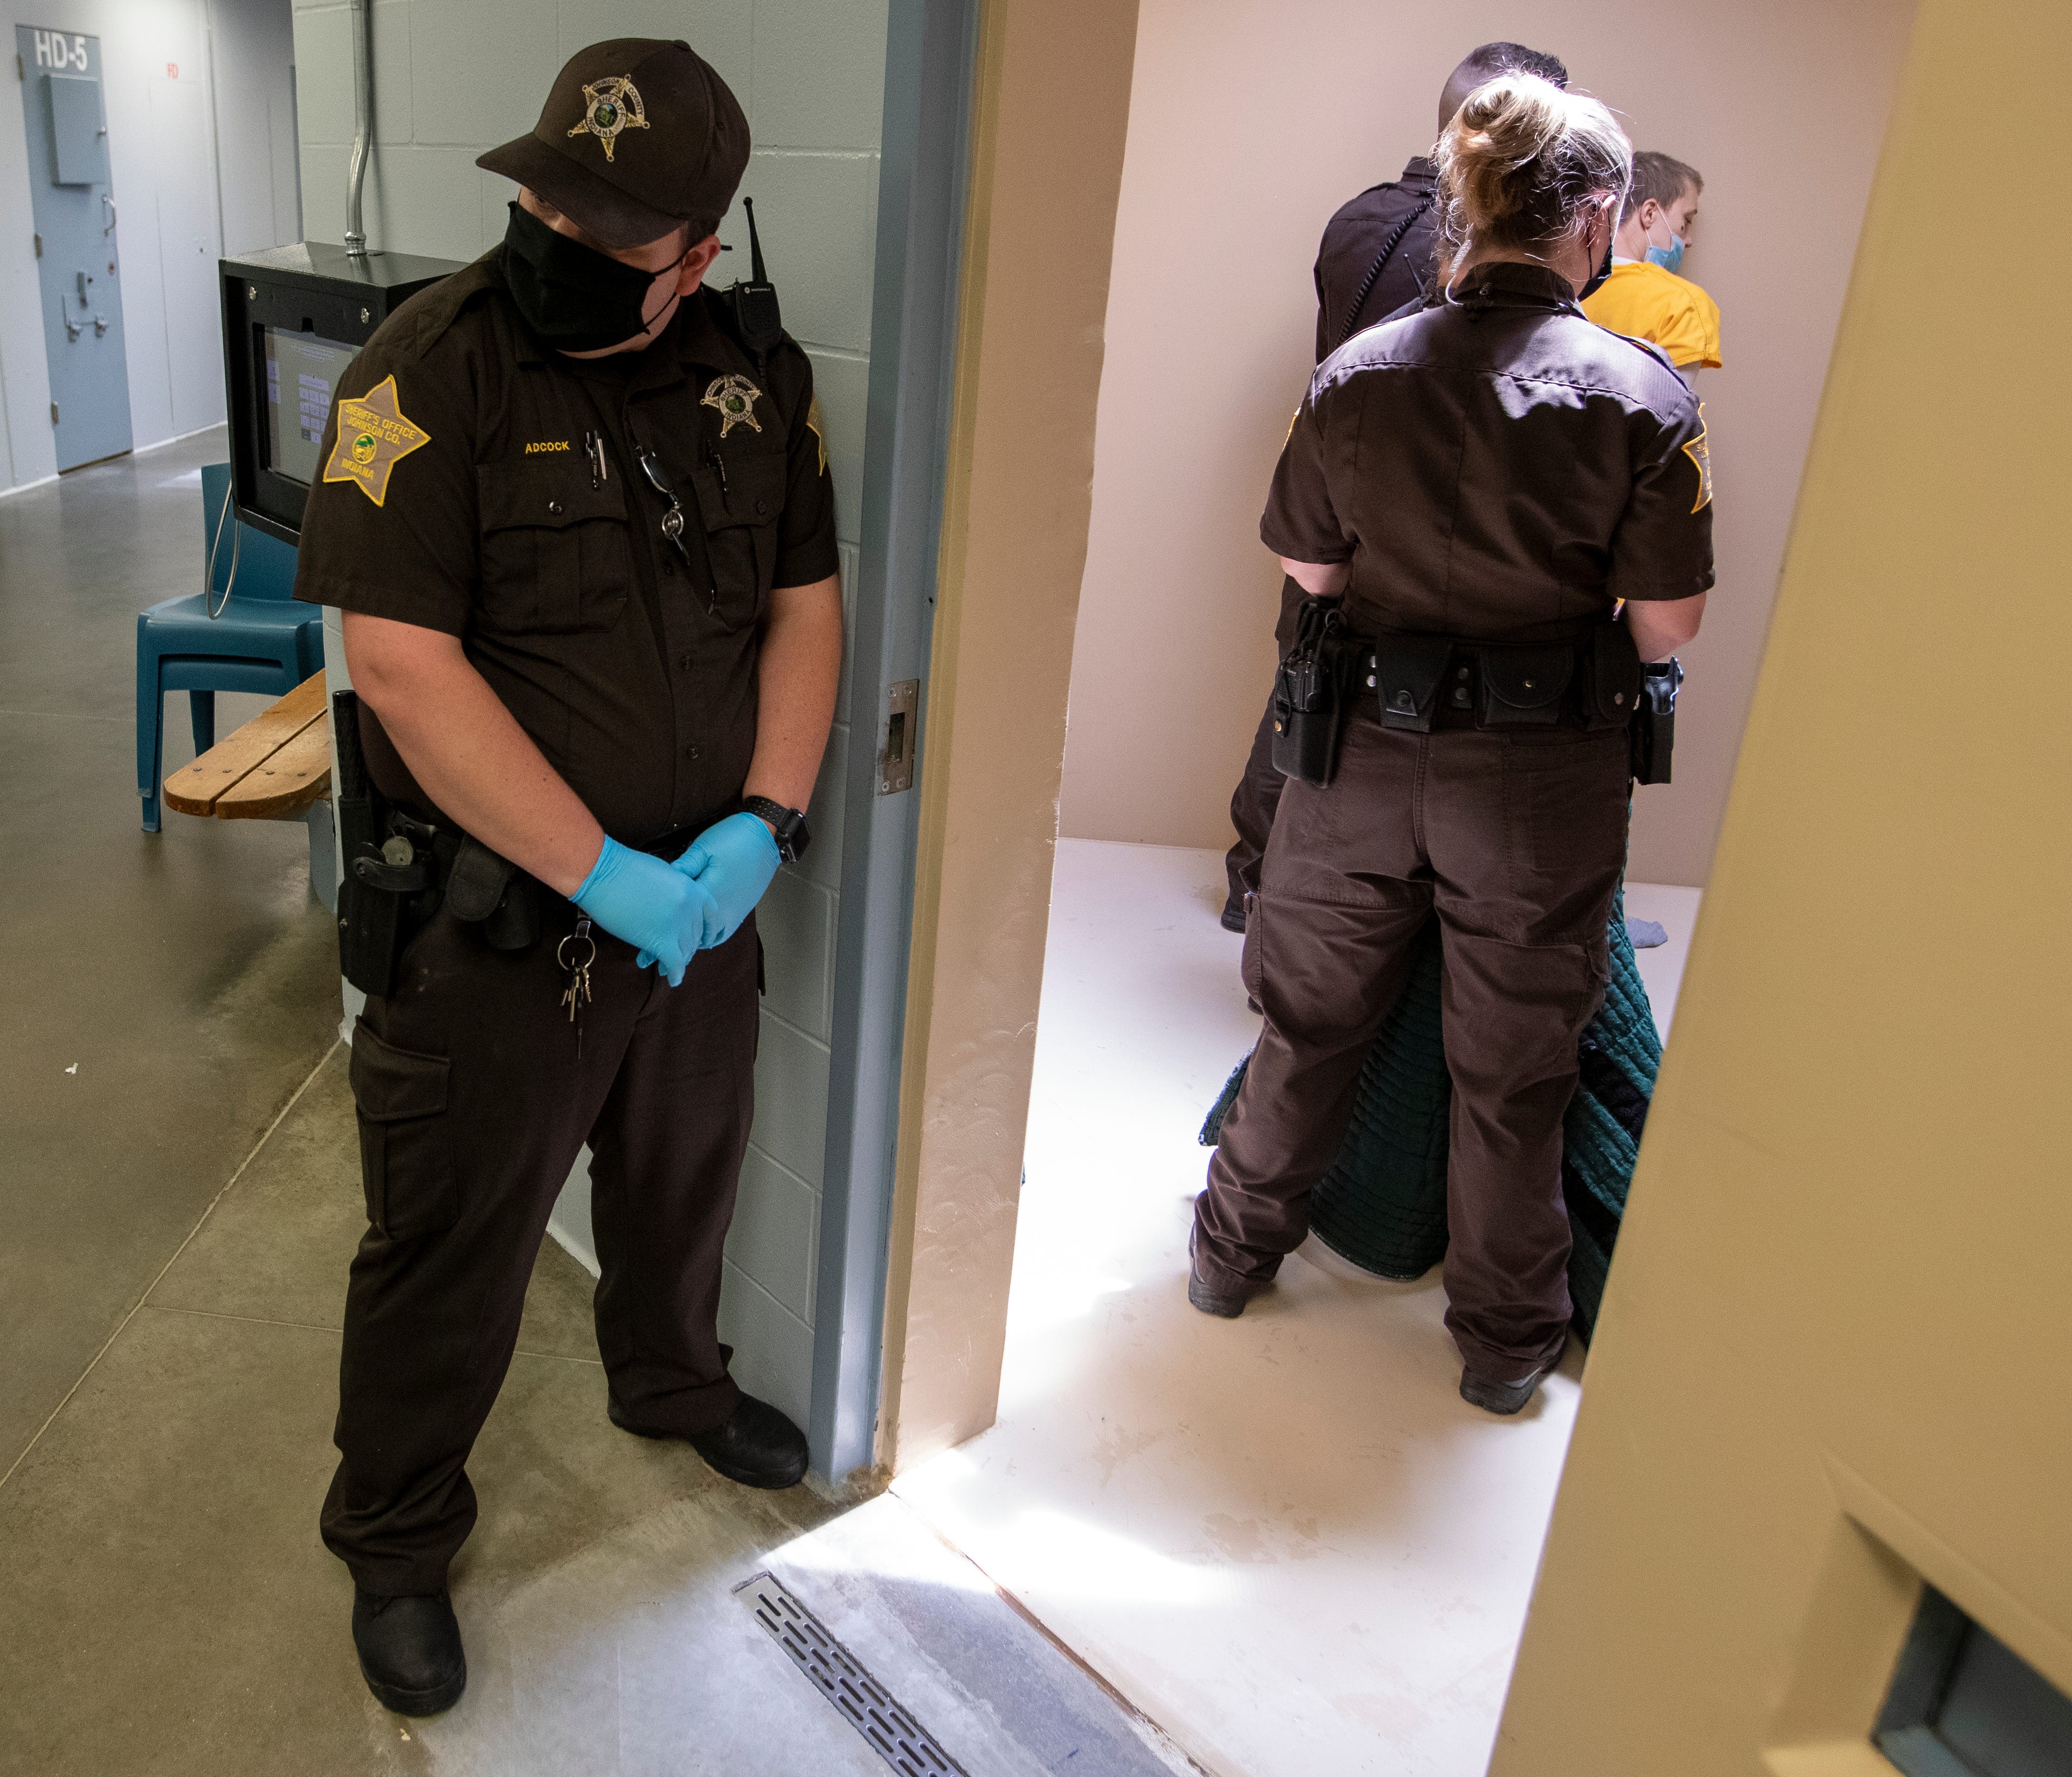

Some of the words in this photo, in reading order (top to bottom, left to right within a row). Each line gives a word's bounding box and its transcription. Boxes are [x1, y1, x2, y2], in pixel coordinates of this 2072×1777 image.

[34, 30, 88, 71] HD-5
[597, 96, 625, 117] SHERIFF
[628, 87, 643, 115] COUNTY
[588, 117, 614, 136] INDIANA
[735, 375, 755, 389] COUNTY
[721, 388, 748, 401] SHERIFF
[344, 404, 380, 425] SHERIFF'S
[382, 419, 417, 440] OFFICE
[725, 410, 751, 419] INDIANA
[347, 417, 384, 439] JOHNSON
[385, 431, 400, 445] CO.
[525, 441, 570, 454] ADCOCK
[341, 458, 374, 480] INDIANA
